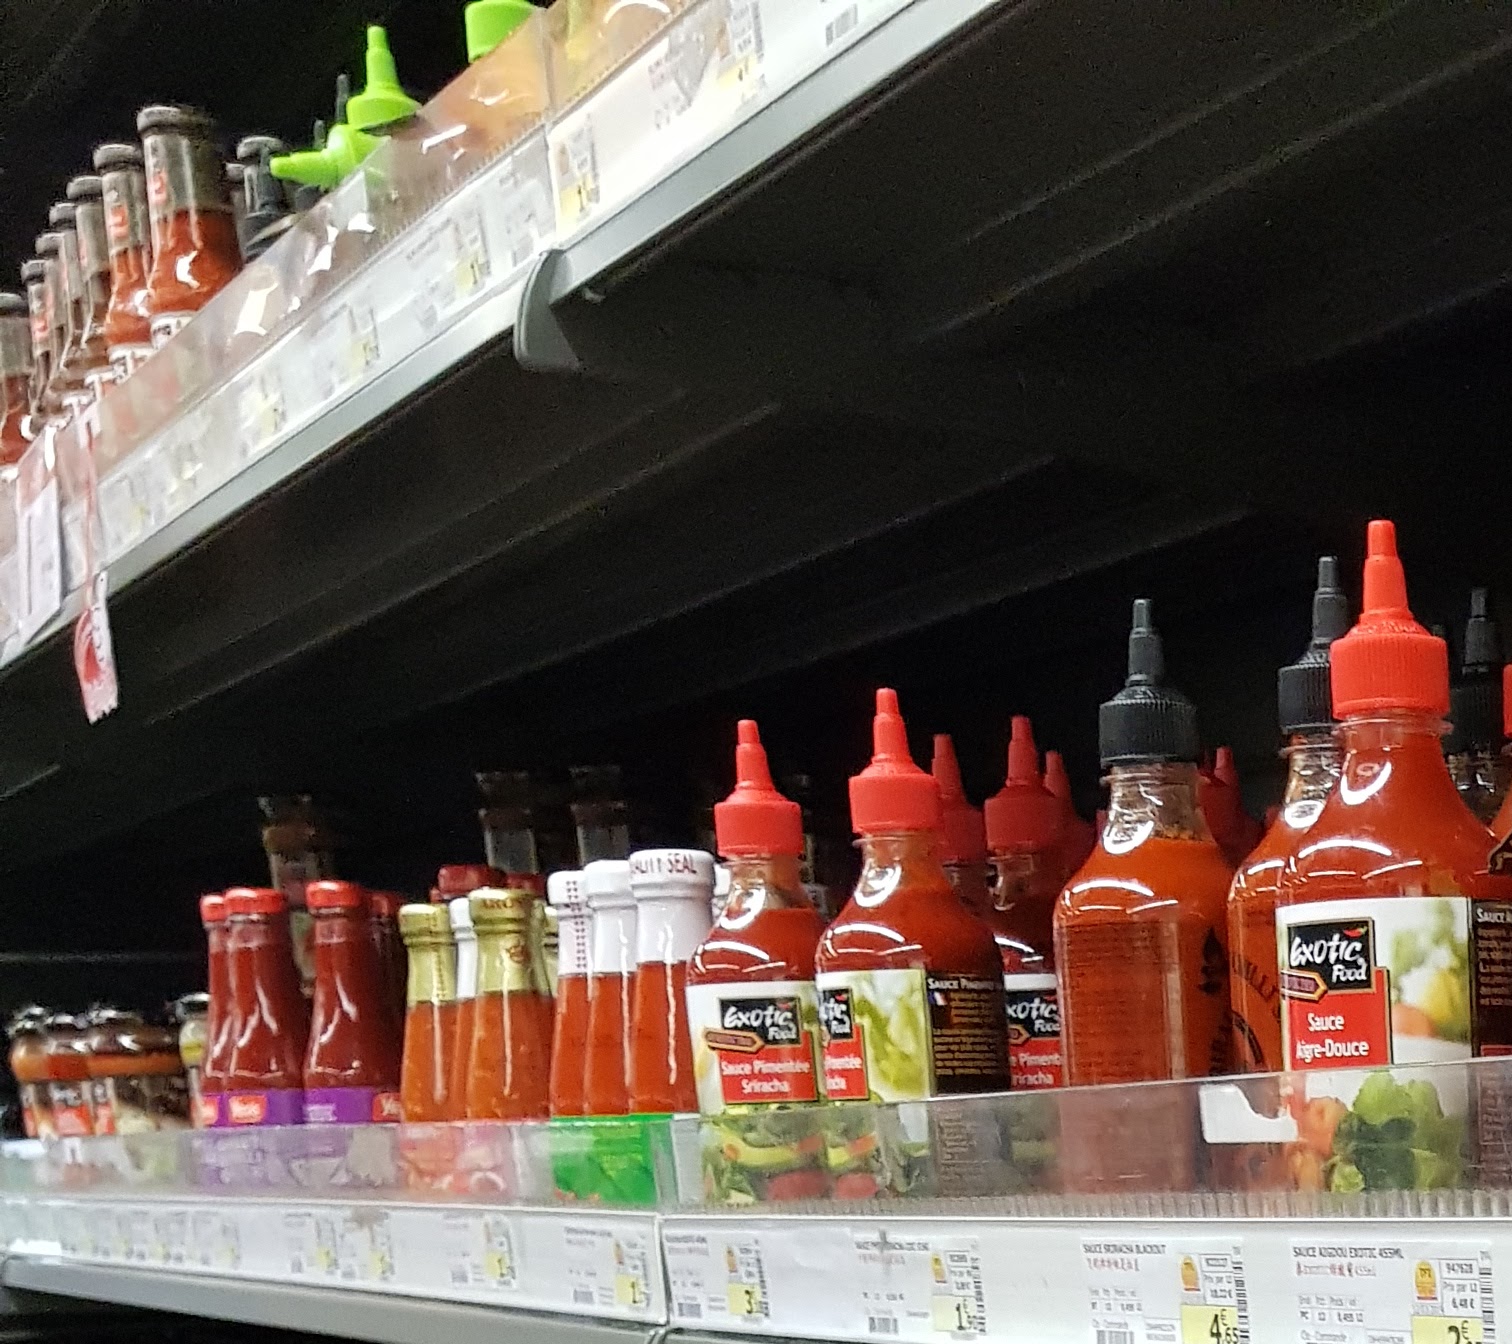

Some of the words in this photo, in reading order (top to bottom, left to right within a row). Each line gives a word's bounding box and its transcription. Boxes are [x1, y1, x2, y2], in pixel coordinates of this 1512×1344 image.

[667, 853, 698, 875] SEAL
[1289, 933, 1363, 967] Exotic
[1331, 961, 1368, 983] Food
[724, 1005, 794, 1029] Exotic
[1307, 1012, 1345, 1032] Sauce
[767, 1021, 798, 1041] Food
[721, 1060, 751, 1075] Sauce
[753, 1059, 811, 1075] Pimentée
[741, 1078, 791, 1094] Sriracha
